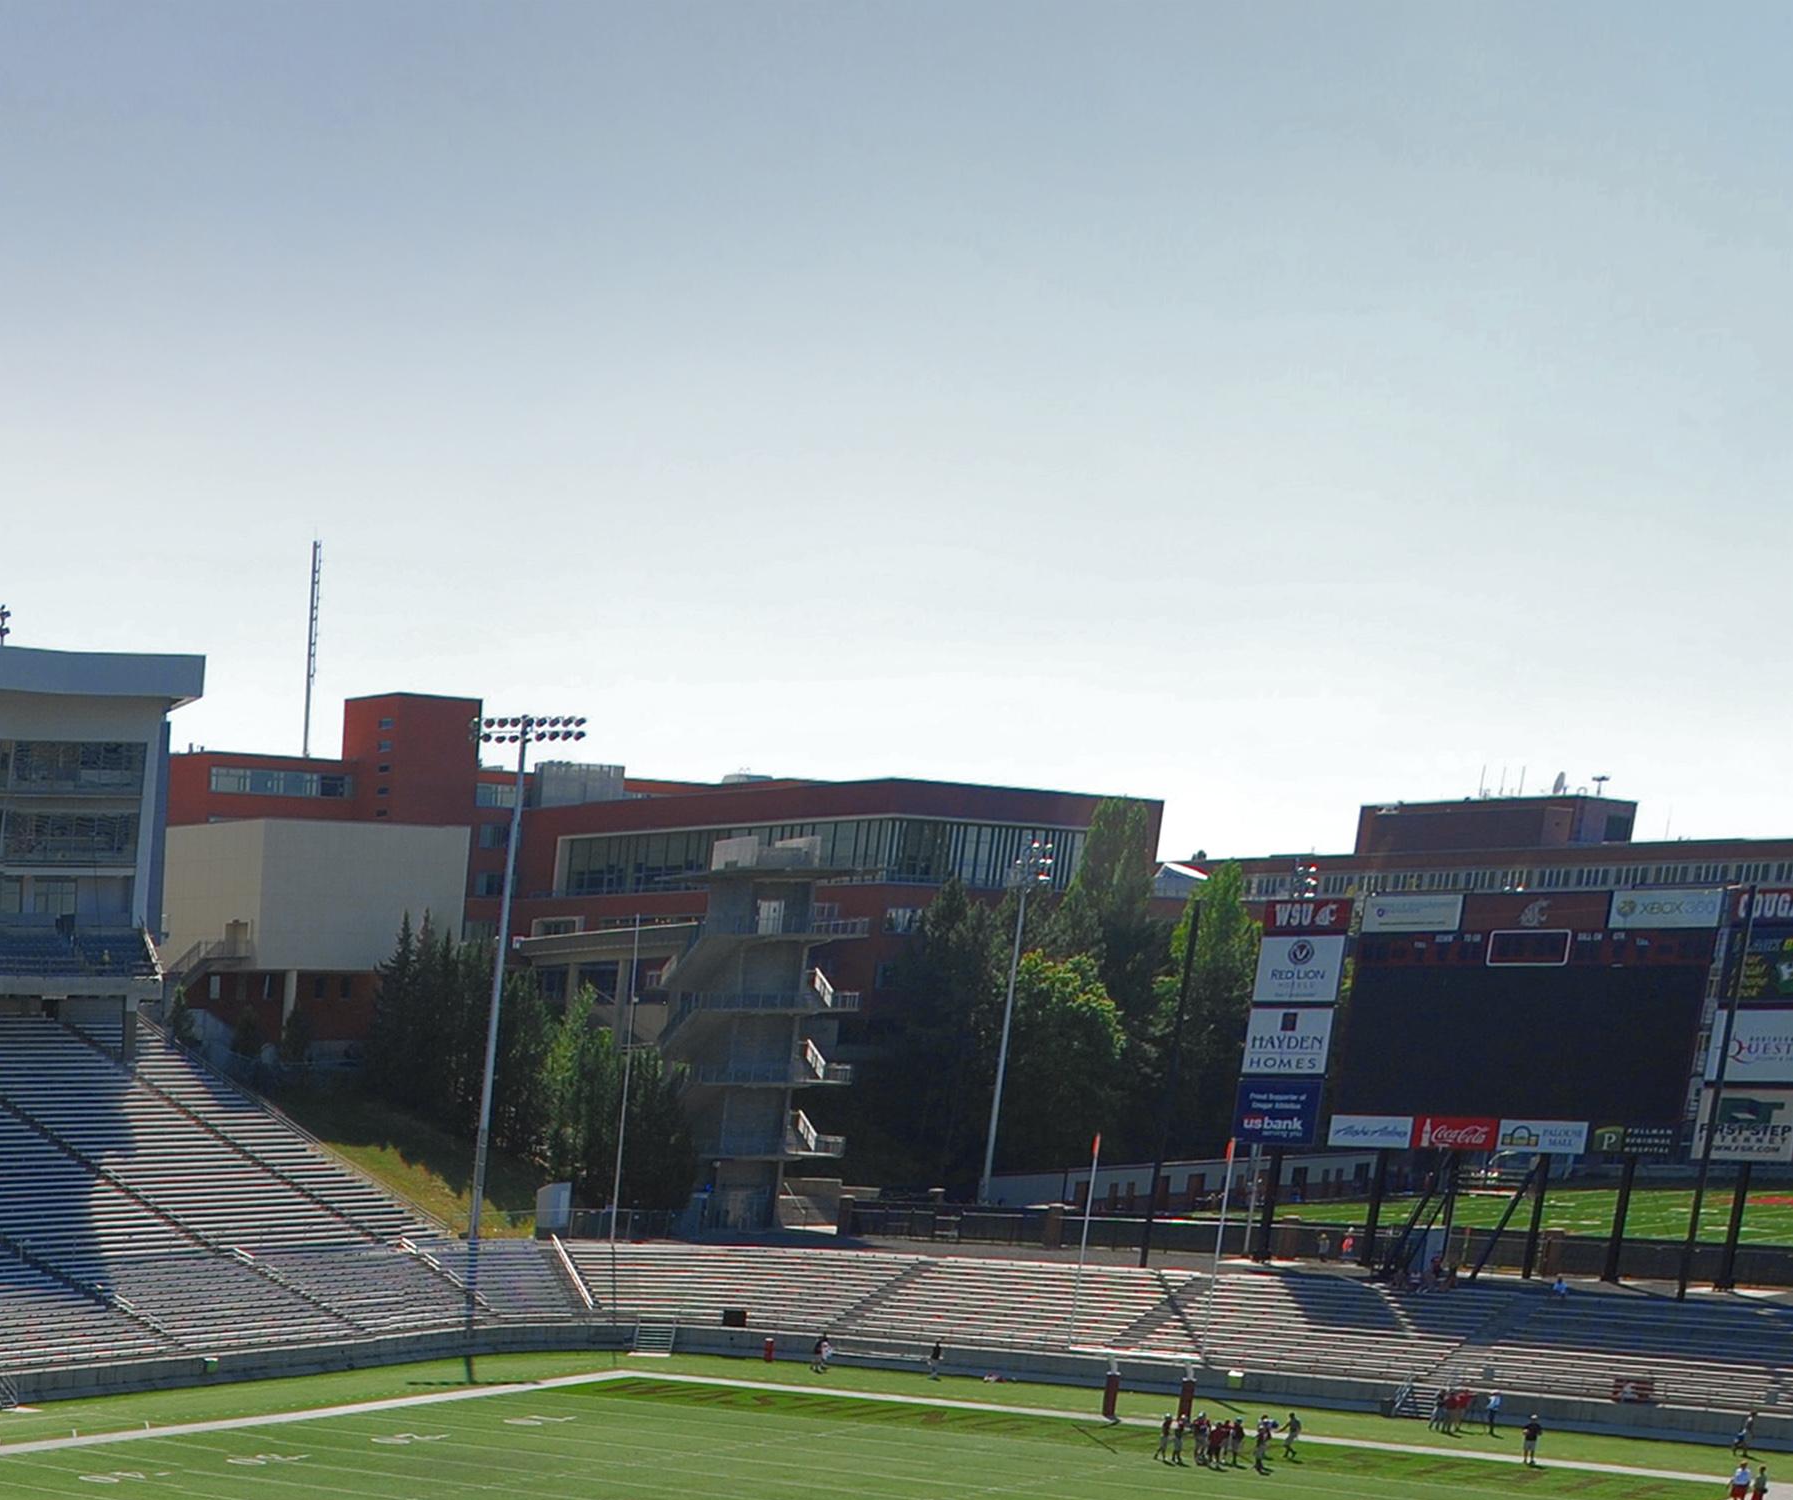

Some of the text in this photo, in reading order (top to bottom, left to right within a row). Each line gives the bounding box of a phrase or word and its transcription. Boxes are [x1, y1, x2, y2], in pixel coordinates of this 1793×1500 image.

[1275, 904, 1313, 927] WSU
[1640, 902, 1684, 915] XBOX
[1270, 969, 1326, 981] RED LION
[1251, 1035, 1324, 1050] HAYDEN
[1249, 1057, 1317, 1069] HOMES
[1431, 1124, 1490, 1145] Coca-Cola
[1602, 1133, 1616, 1150] P
